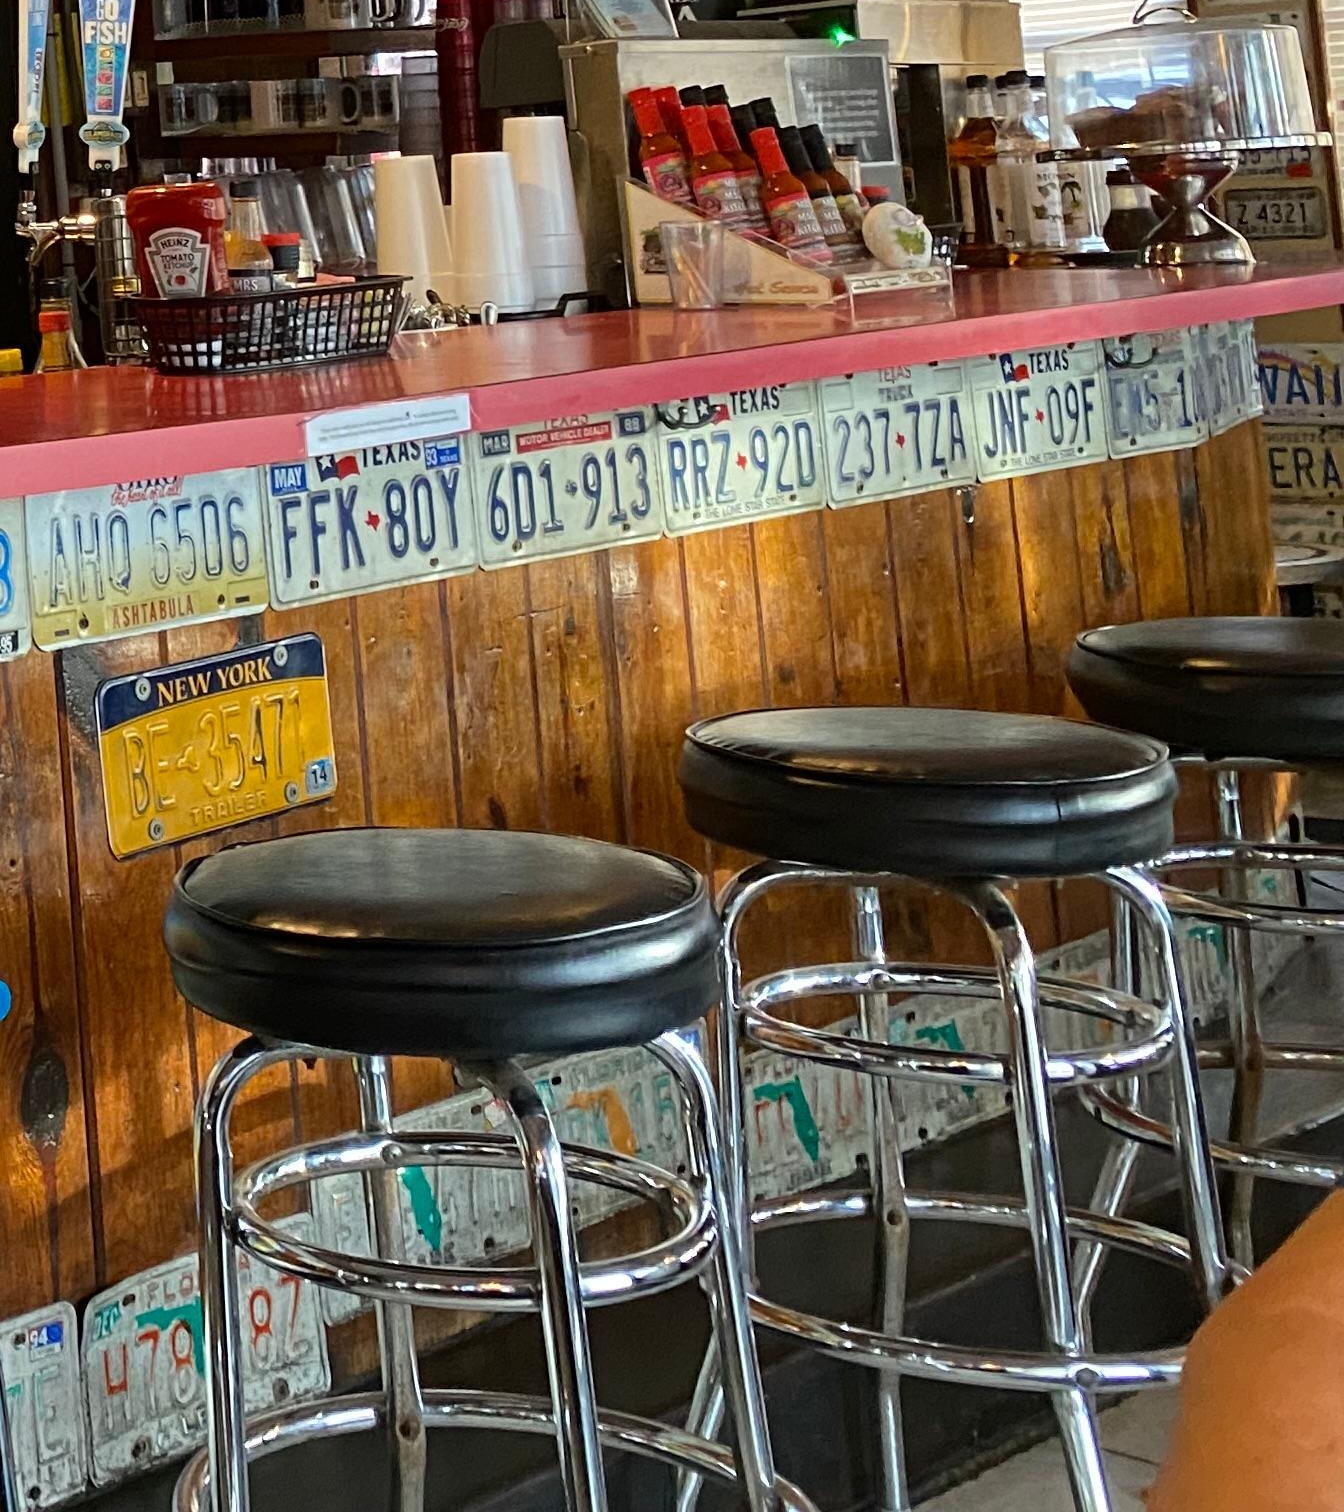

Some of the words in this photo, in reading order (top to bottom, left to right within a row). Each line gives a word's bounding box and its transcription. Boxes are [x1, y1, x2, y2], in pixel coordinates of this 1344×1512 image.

[85, 21, 128, 45] FISH
[1257, 202, 1309, 227] 4321
[161, 238, 190, 250] HEINZ
[161, 252, 195, 263] TOMATO
[163, 261, 194, 270] KETCHUP
[233, 279, 259, 292] MRS
[1028, 349, 1070, 375] TEXAS
[728, 385, 781, 417] TEXAS
[984, 387, 1031, 459] JNF
[1045, 377, 1096, 446] 09F
[482, 436, 509, 456] MAR
[518, 431, 545, 448] MOTOR
[547, 427, 579, 444] VEHICLE
[833, 408, 892, 484] 237
[902, 396, 968, 472] 7ZA
[274, 467, 303, 489] MAY
[362, 440, 422, 468] TEXAS
[668, 429, 737, 514] RRZ
[582, 441, 652, 531] 913
[277, 484, 366, 579] FFK
[383, 466, 460, 559] 80Y
[112, 594, 195, 628] ASHTABULA
[156, 670, 213, 708] NEW
[216, 655, 274, 690] YORK
[310, 765, 329, 786] 14
[190, 790, 269, 827] TRAILER
[29, 1327, 50, 1348] 94
